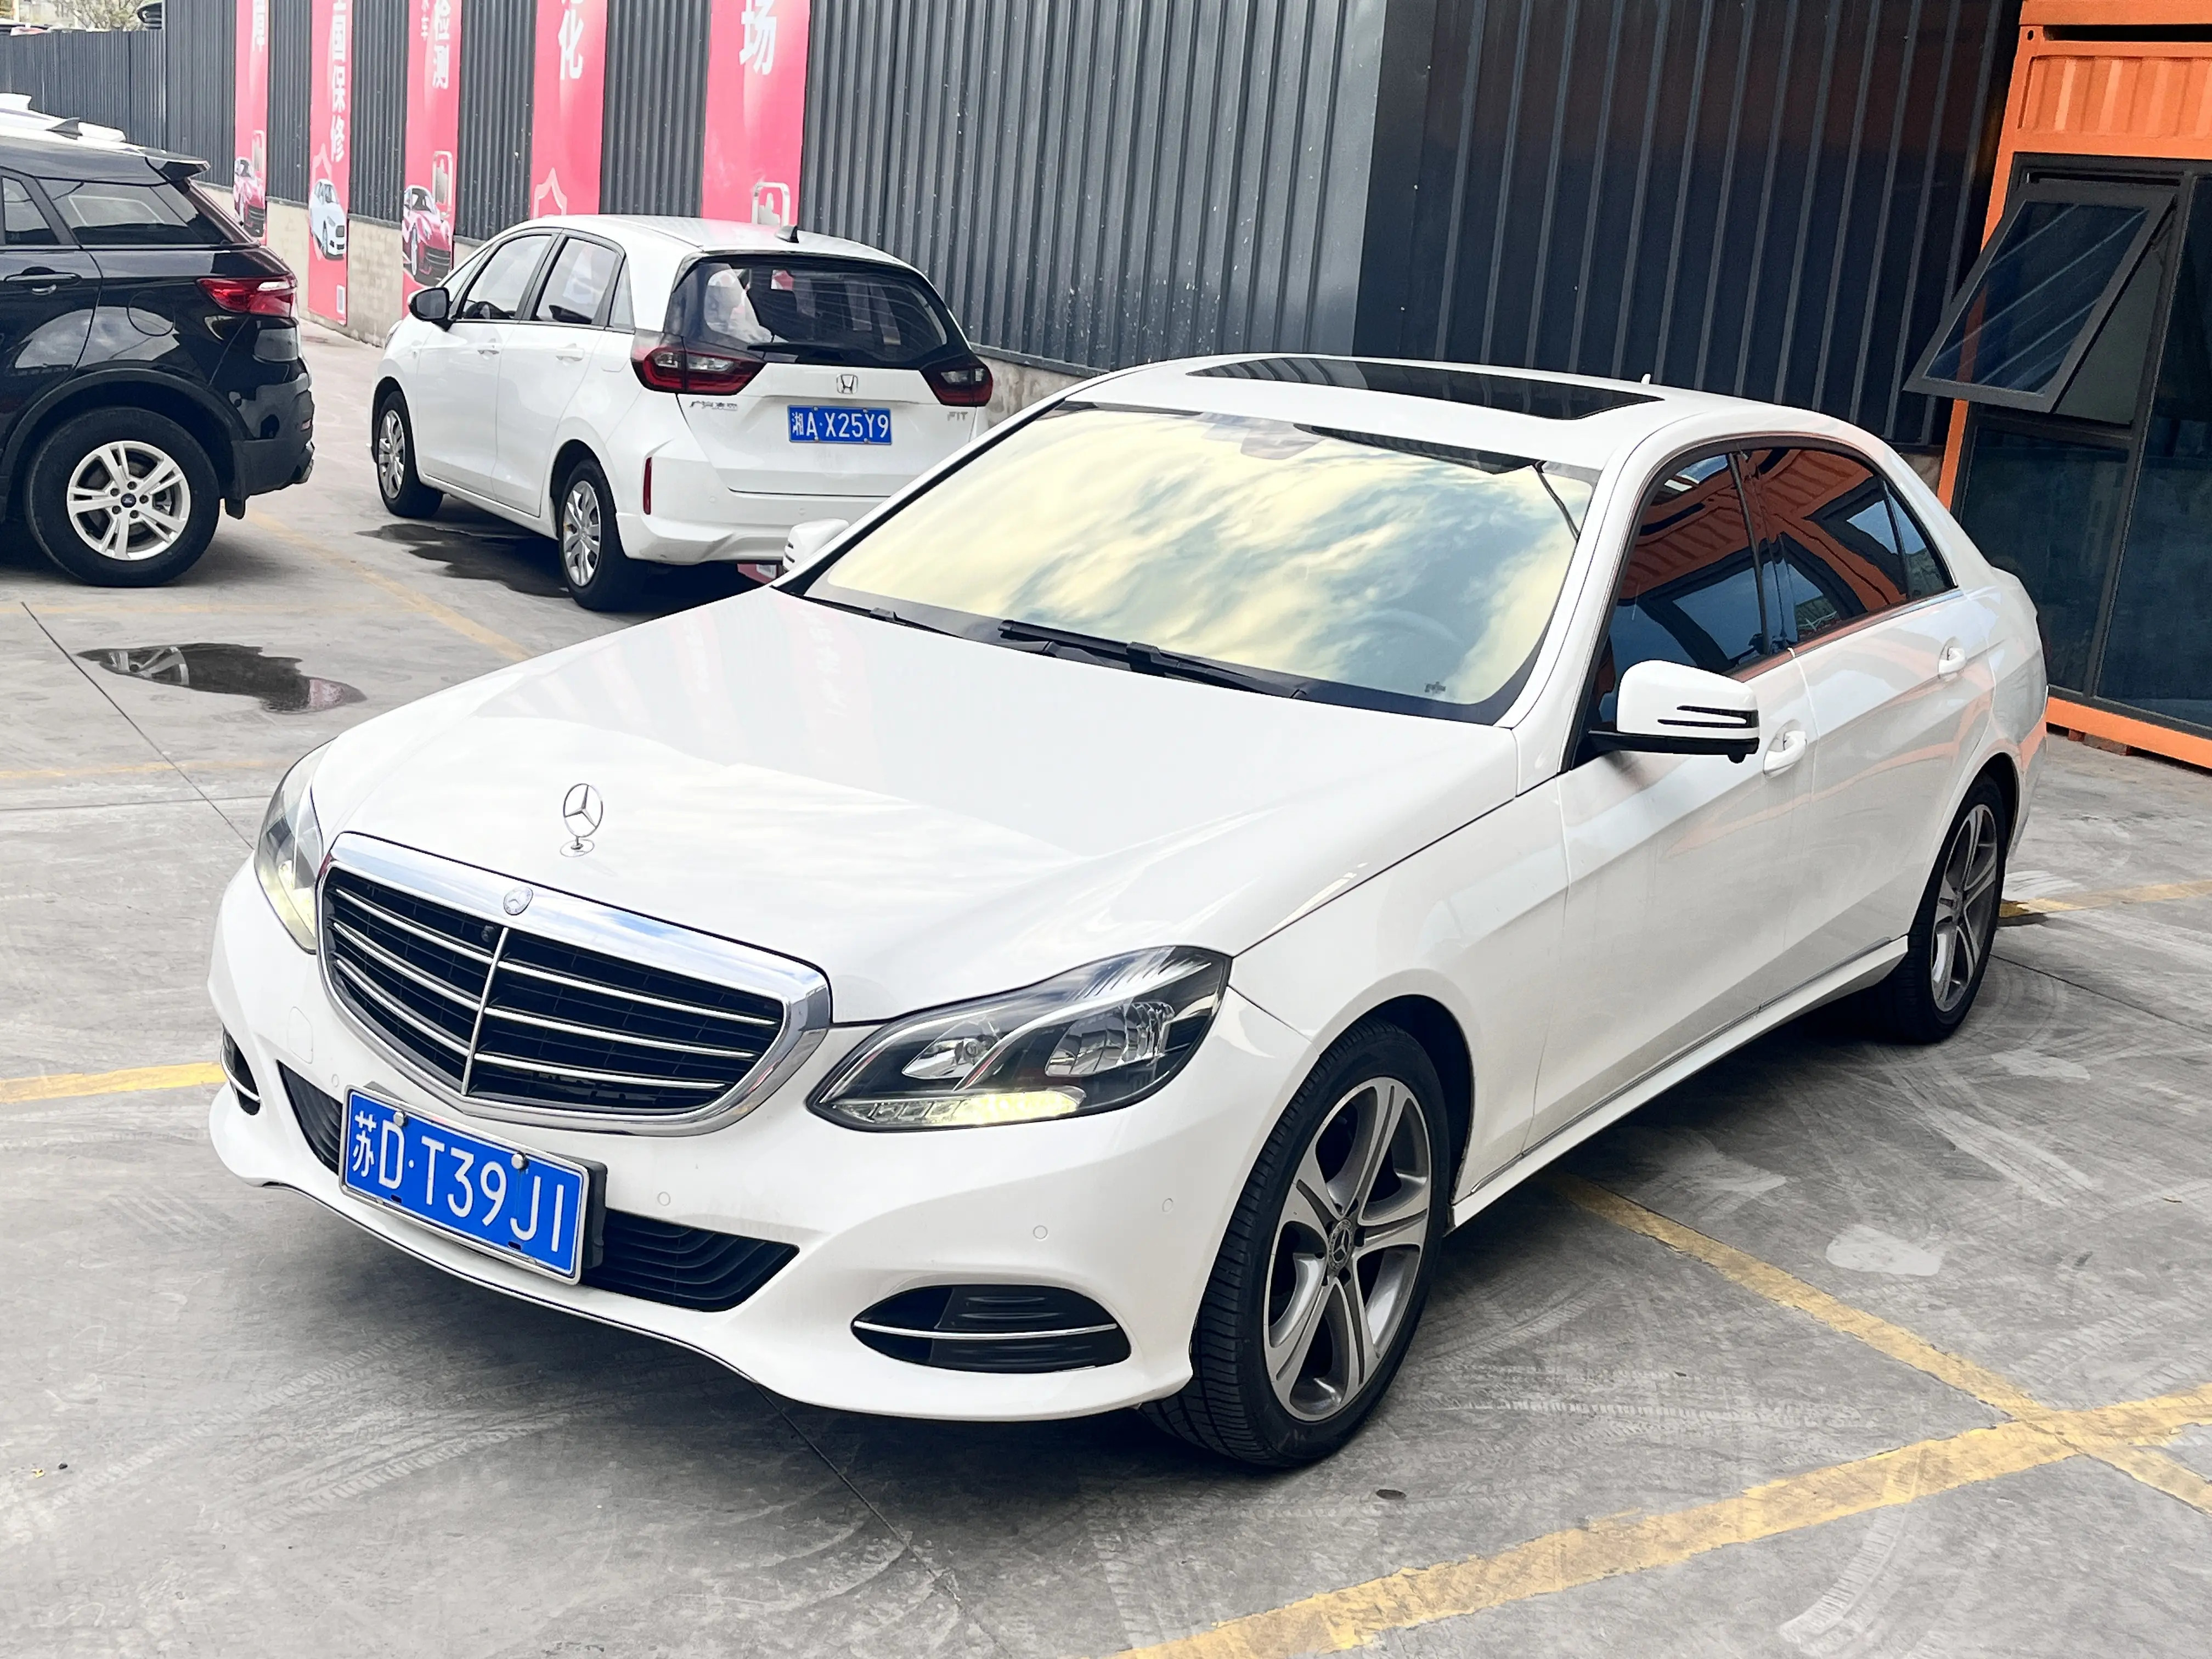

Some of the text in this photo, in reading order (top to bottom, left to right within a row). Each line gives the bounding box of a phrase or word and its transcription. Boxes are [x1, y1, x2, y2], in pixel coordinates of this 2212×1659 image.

[558, 0, 584, 81] 化
[739, 0, 777, 75] 场
[330, 0, 347, 162] 国保修
